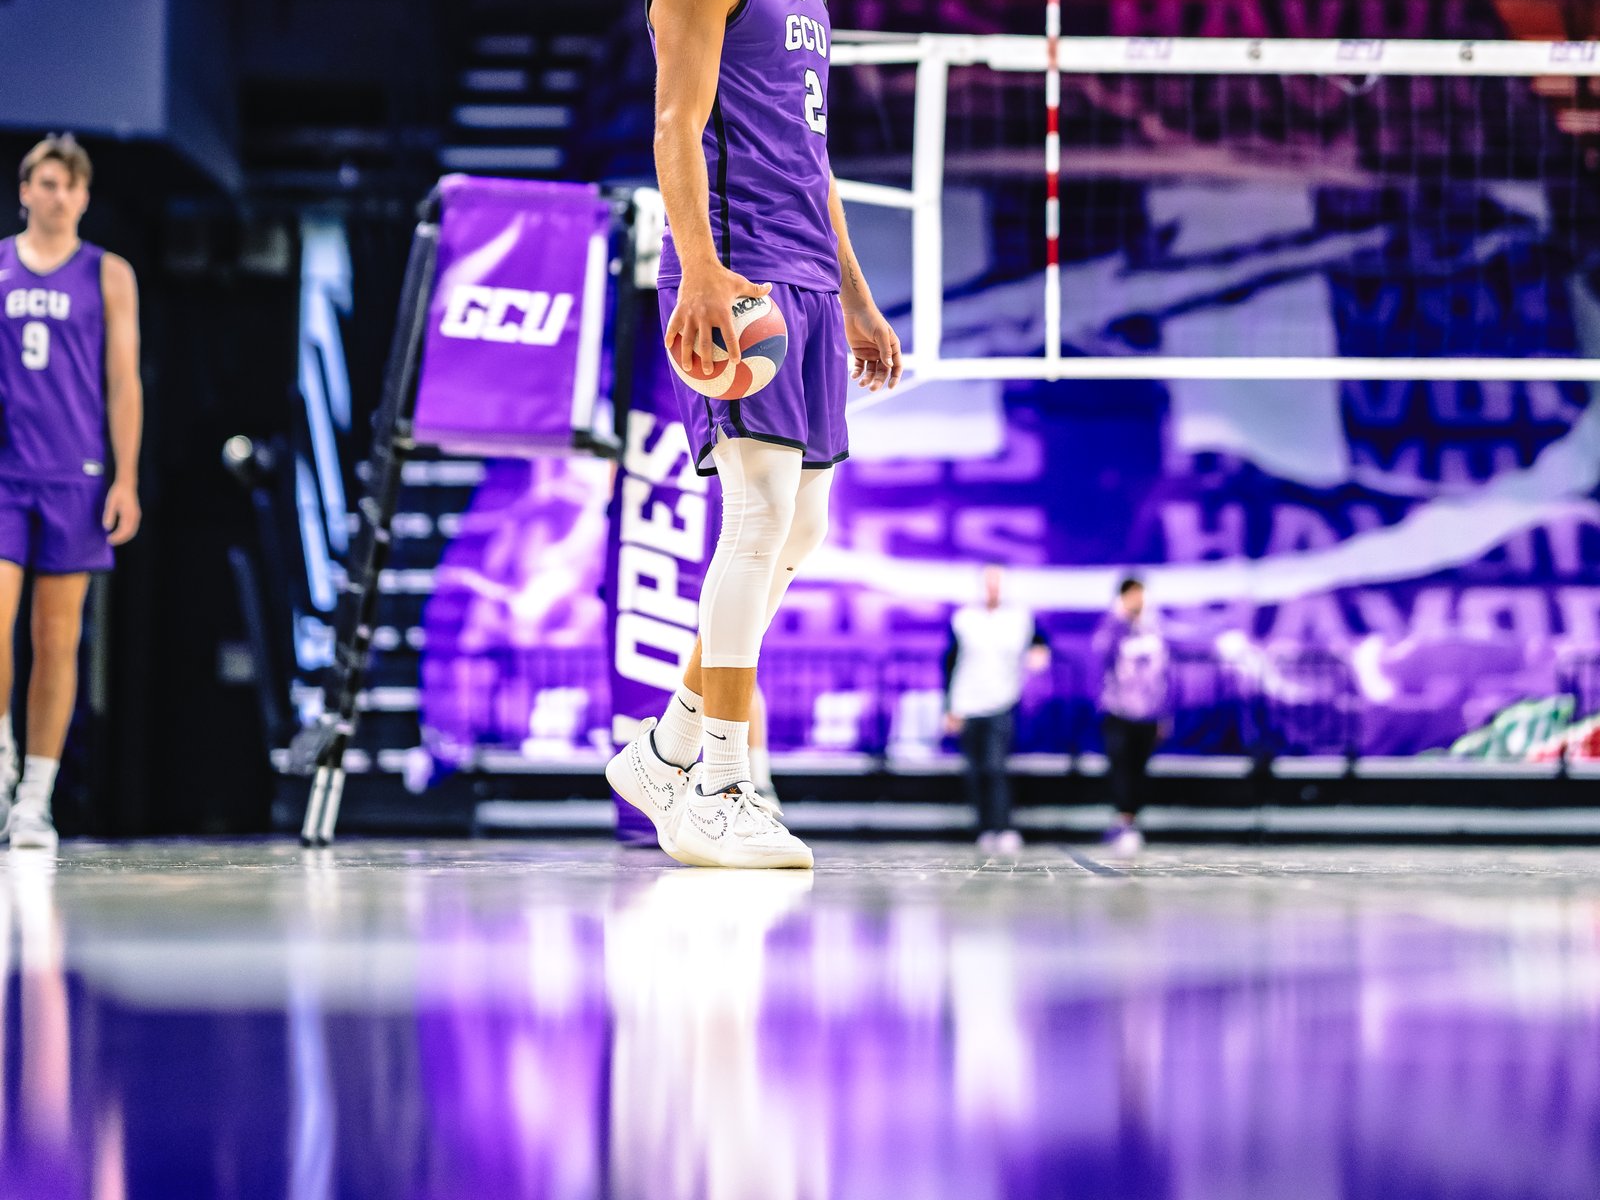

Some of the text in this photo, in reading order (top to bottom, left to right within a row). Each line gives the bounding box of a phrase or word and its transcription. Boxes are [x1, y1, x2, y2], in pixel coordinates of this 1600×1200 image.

[785, 13, 827, 59] GCU
[804, 67, 827, 137] 2
[5, 288, 71, 321] GCU
[439, 284, 575, 347] GCU
[731, 297, 767, 318] NCAA
[21, 320, 50, 371] 9
